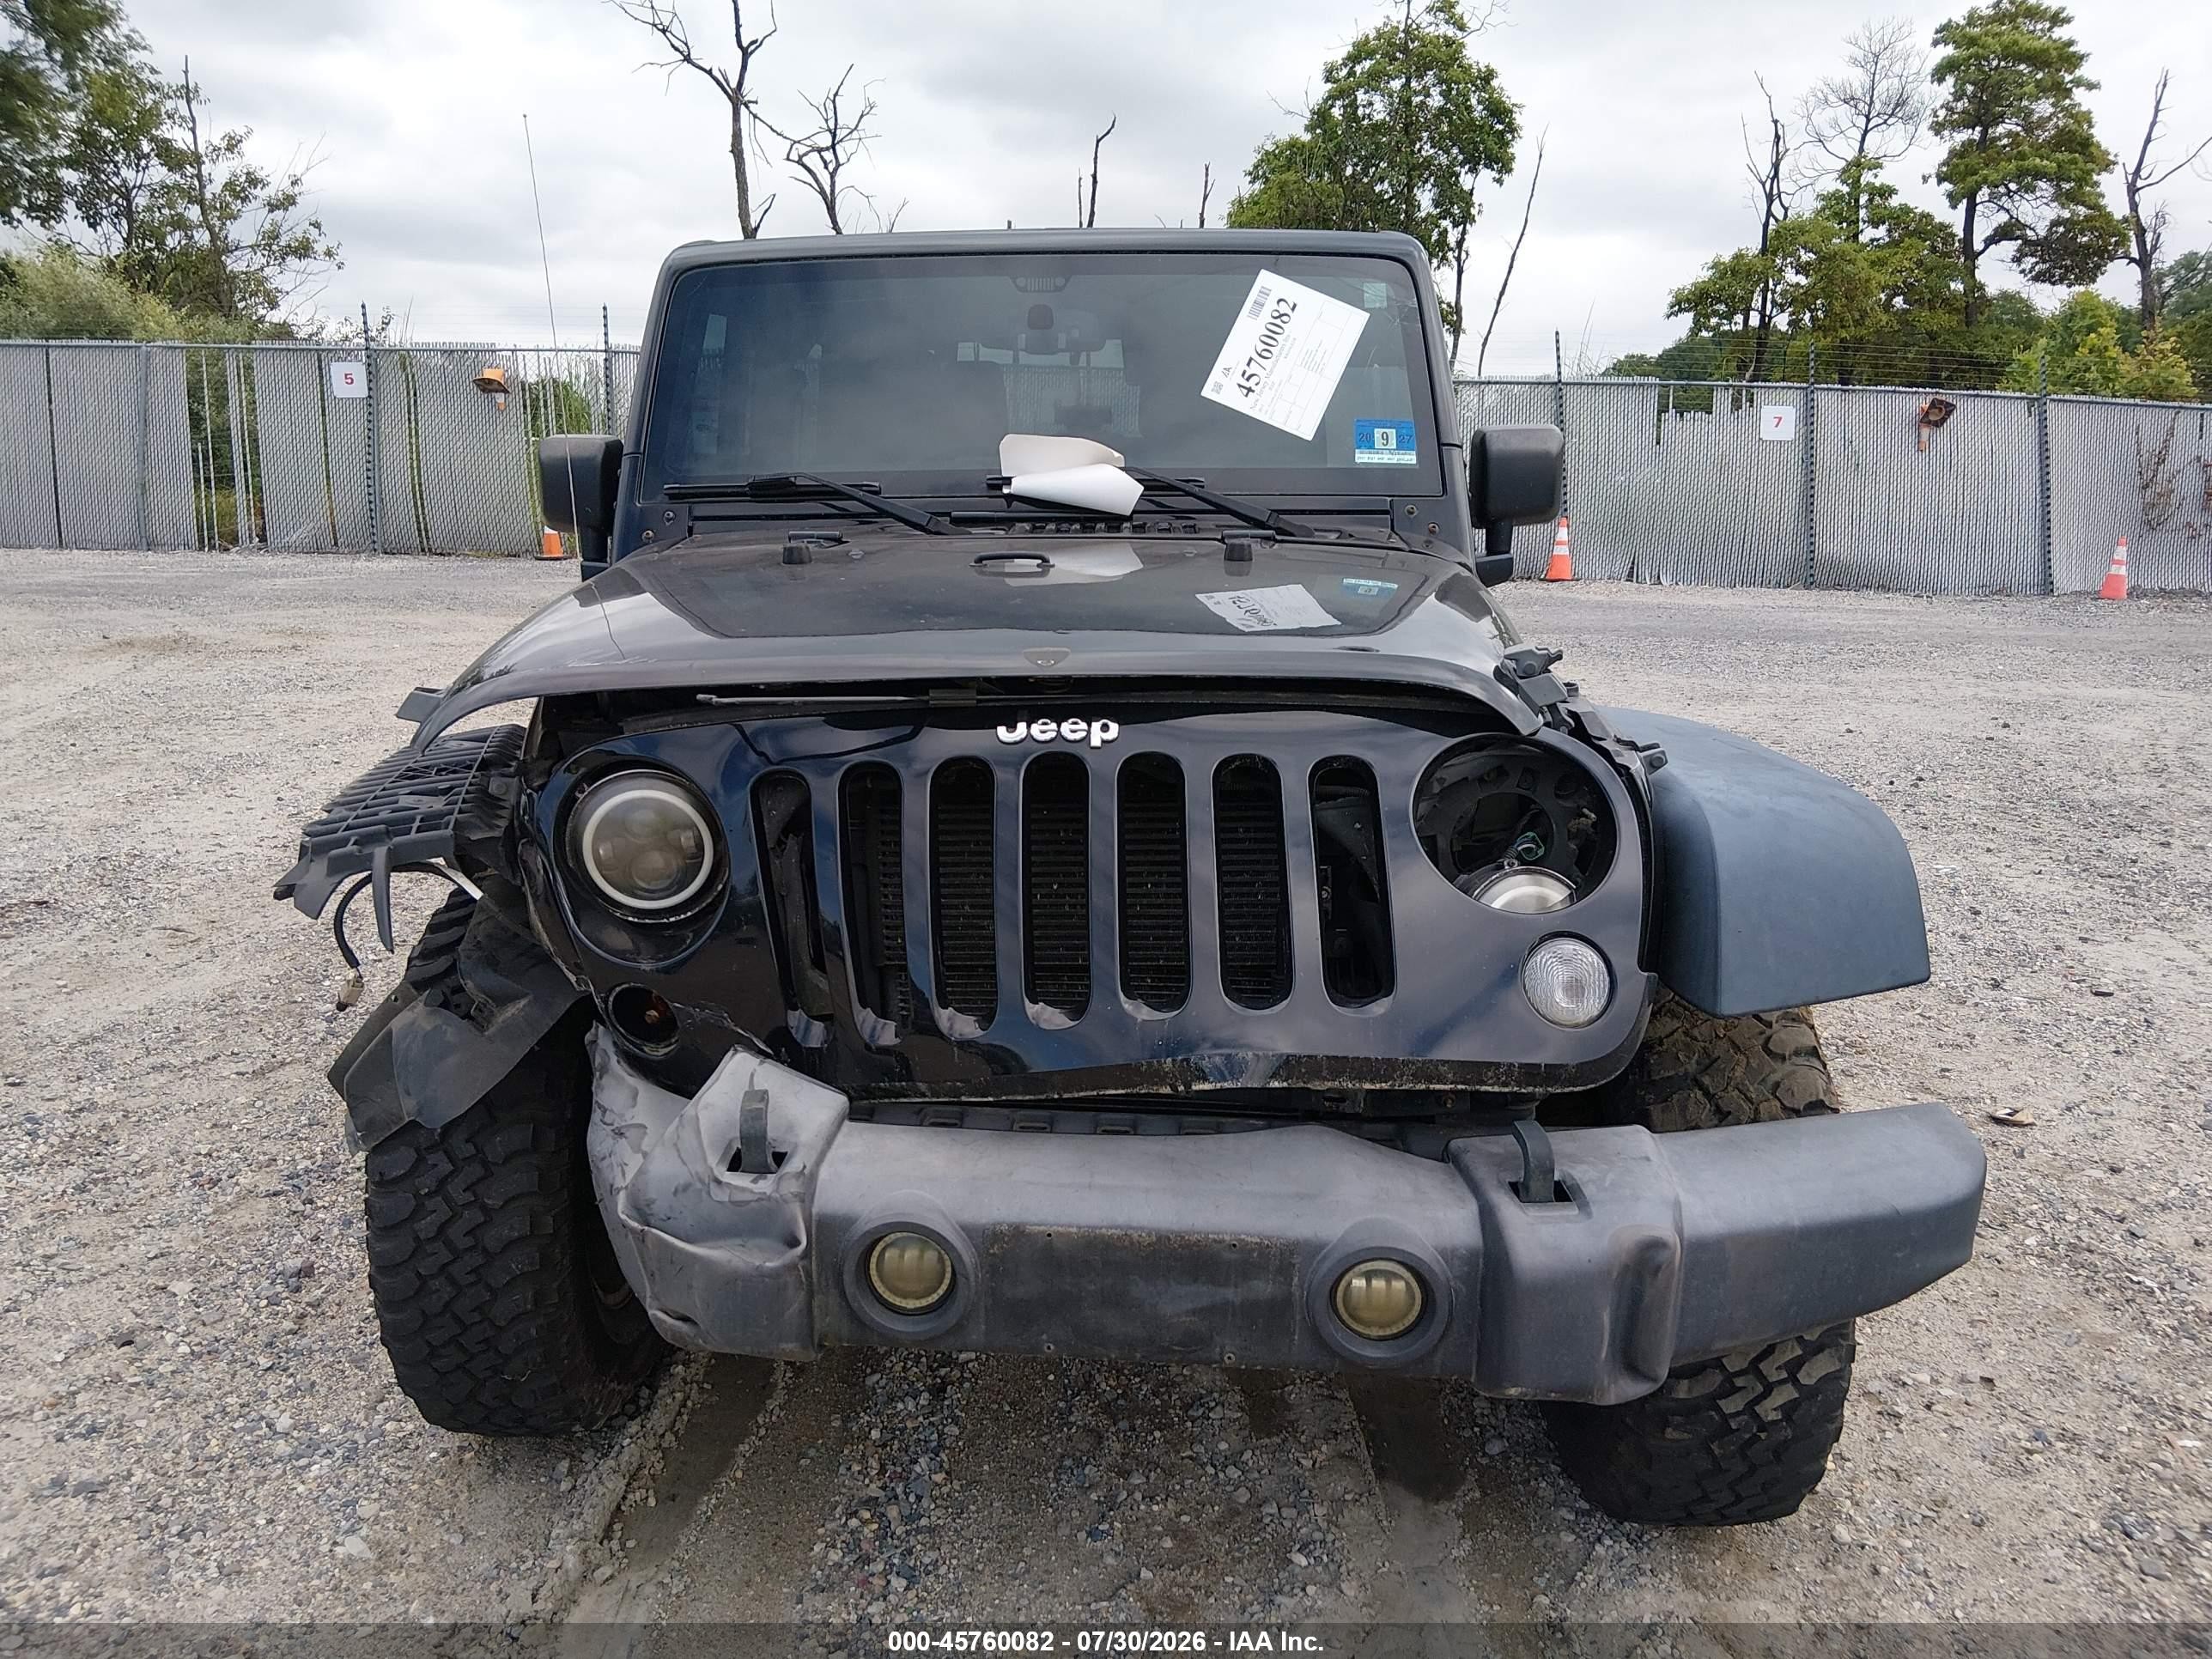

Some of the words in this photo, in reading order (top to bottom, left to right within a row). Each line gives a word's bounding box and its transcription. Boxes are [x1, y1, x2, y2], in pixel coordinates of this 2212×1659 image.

[1236, 297, 1298, 398] 45760082
[343, 373, 355, 386] 5
[1772, 416, 1783, 428] 7
[1381, 431, 1389, 447] 9
[996, 718, 1120, 748] Jeep
